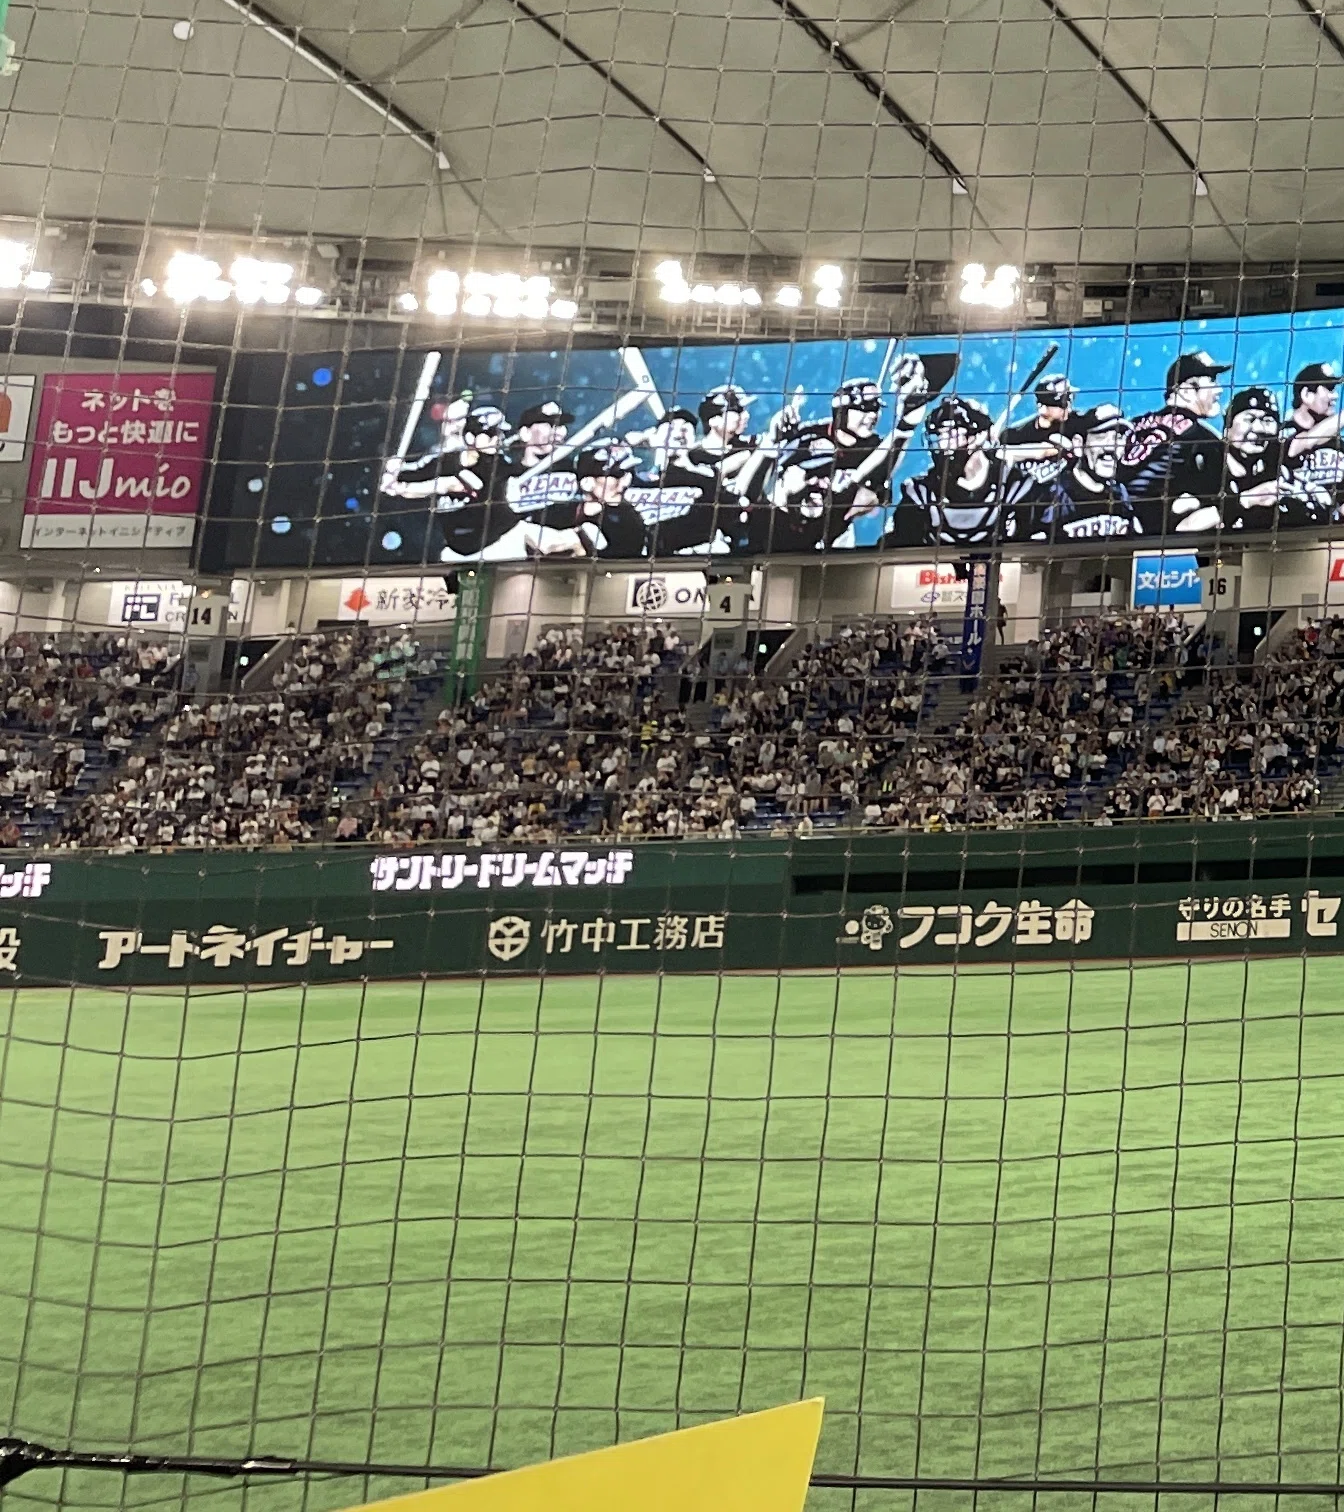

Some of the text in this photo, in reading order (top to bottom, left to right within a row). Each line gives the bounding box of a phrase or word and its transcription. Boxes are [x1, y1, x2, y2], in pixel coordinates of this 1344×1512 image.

[81, 388, 177, 412] ネットを
[52, 419, 200, 444] もっと快適に
[40, 457, 191, 499] IIJmio
[1207, 577, 1227, 596] 16
[190, 607, 211, 626] 14
[719, 595, 731, 613] 4
[370, 849, 634, 891] サントリードリームマッチ
[1178, 893, 1292, 921] 守りの名手
[541, 915, 725, 954] 竹中工務店
[898, 898, 1095, 949] フコク生命
[1210, 922, 1258, 938] SENON
[98, 924, 394, 969] アートネイチャー
